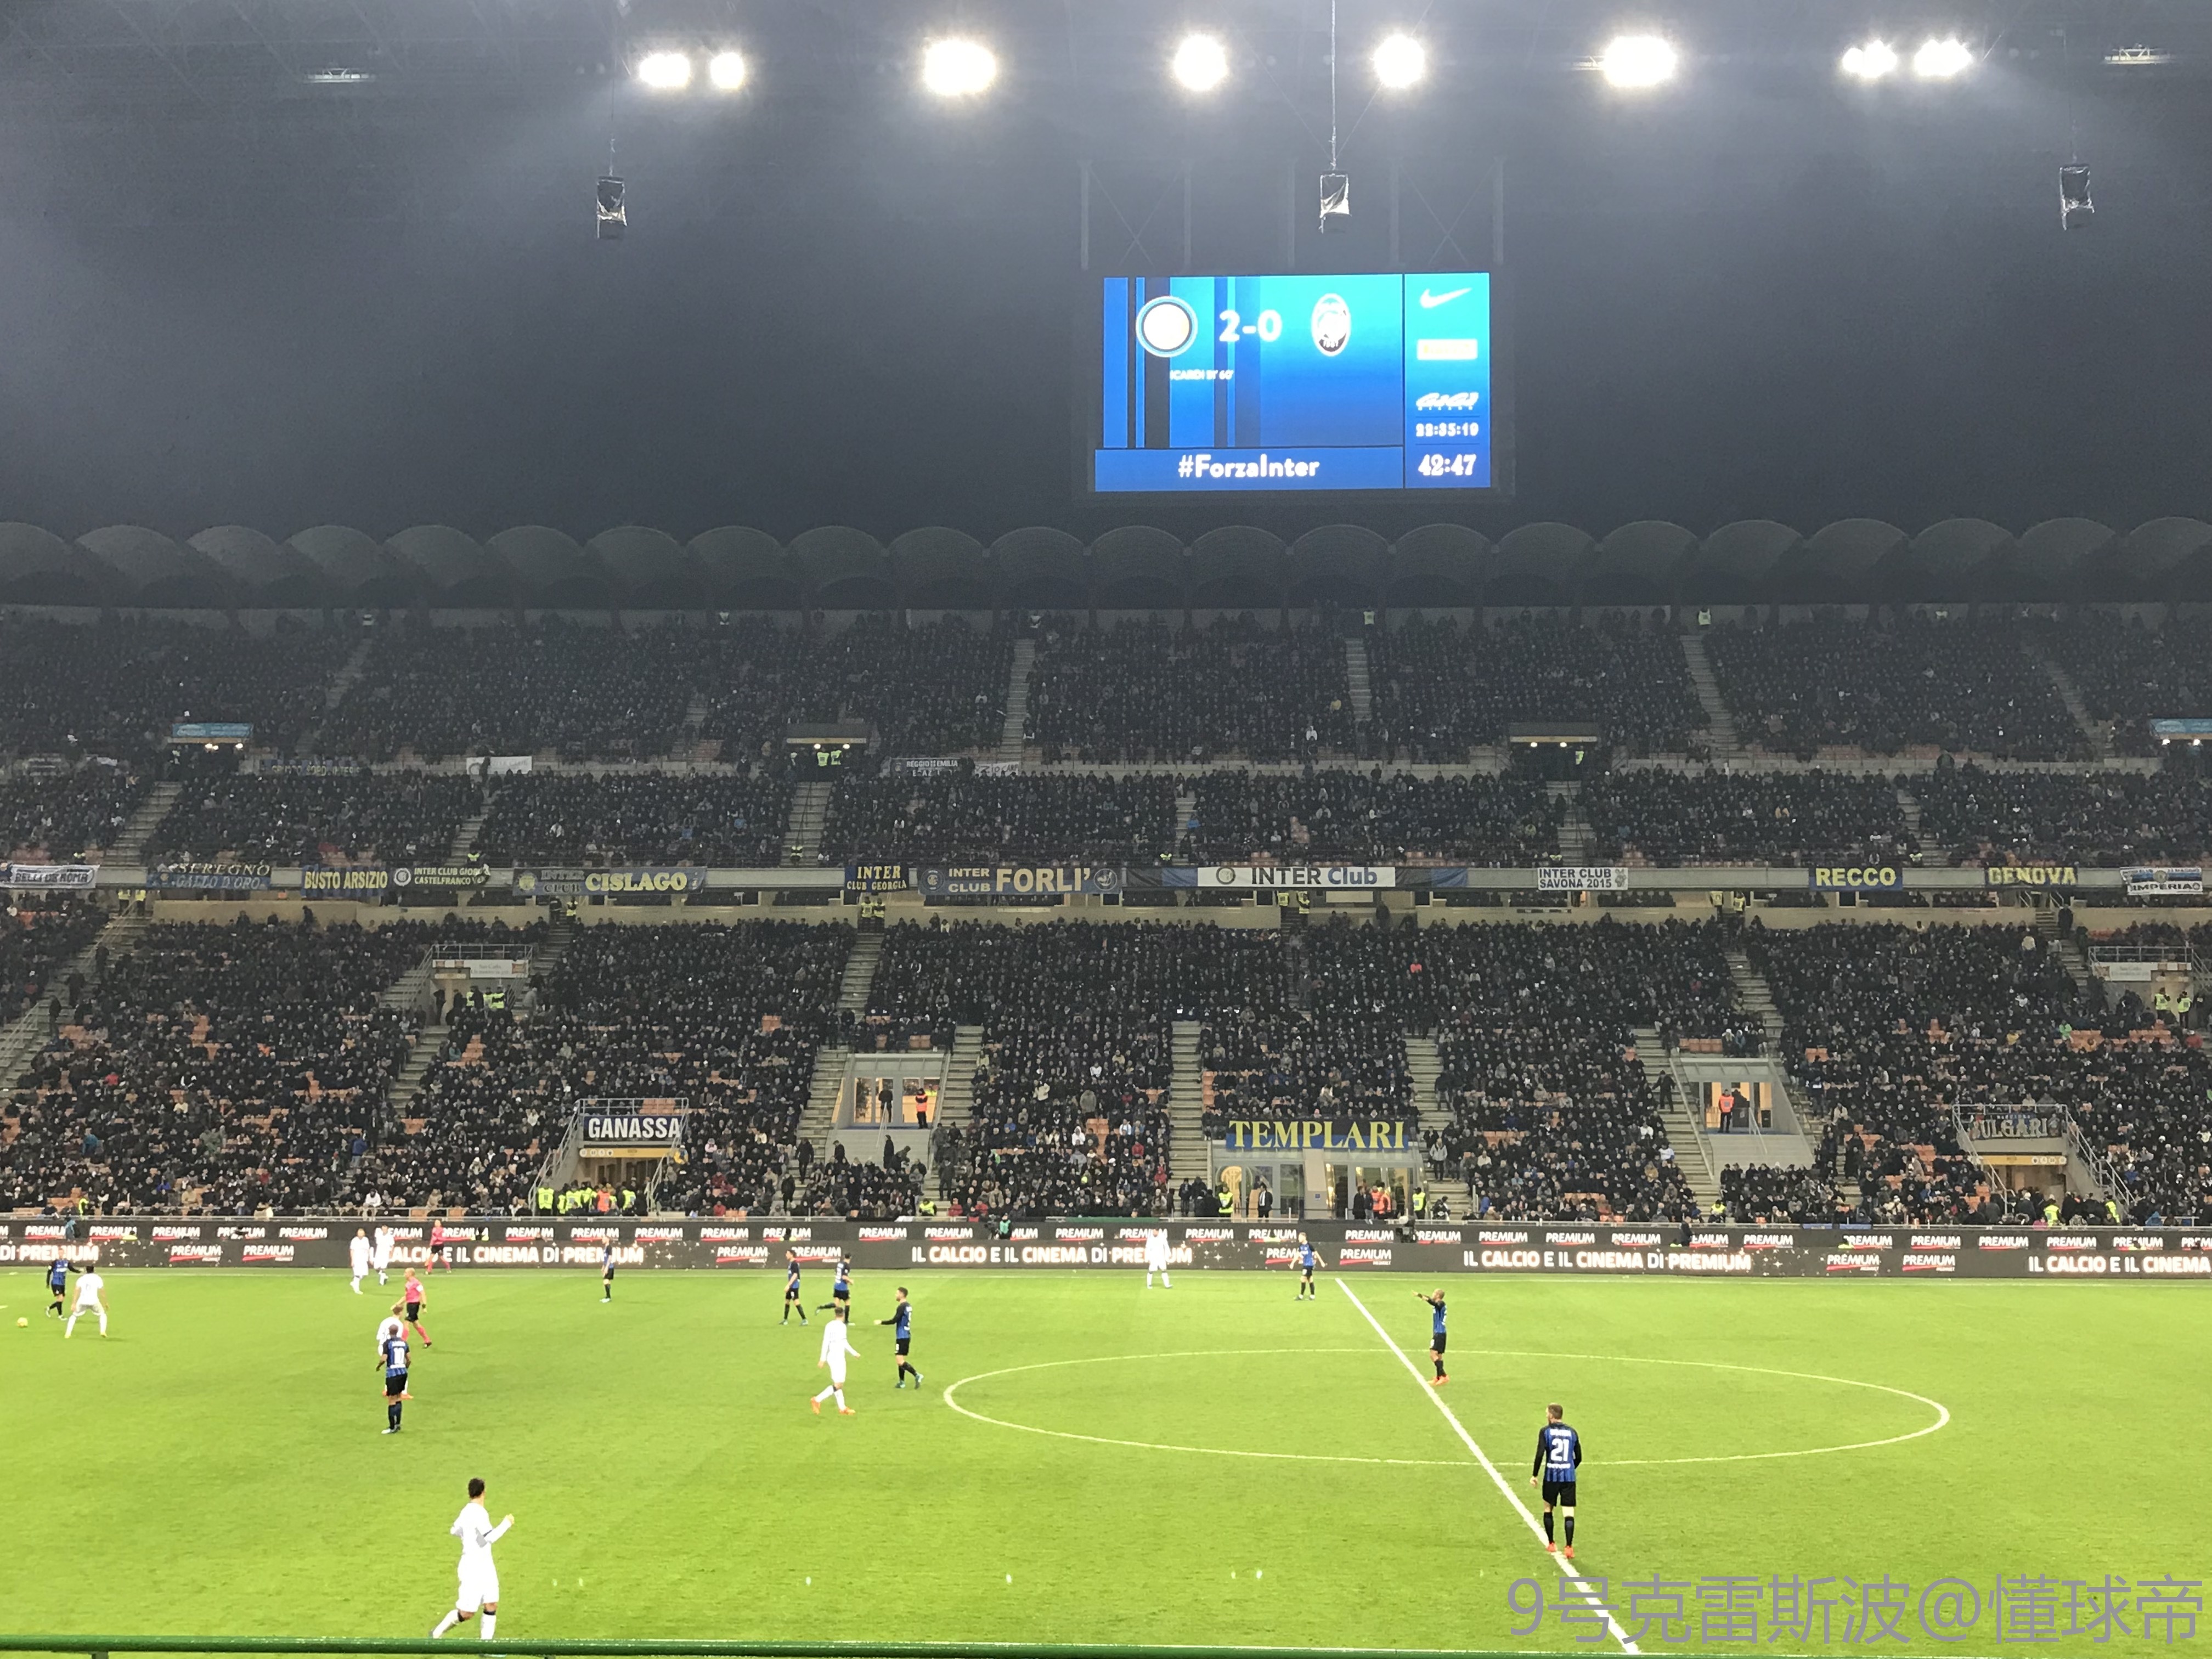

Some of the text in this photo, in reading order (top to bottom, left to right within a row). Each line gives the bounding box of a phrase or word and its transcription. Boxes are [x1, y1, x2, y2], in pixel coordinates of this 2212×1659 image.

[1218, 309, 1283, 342] 2-0
[1178, 455, 1320, 478] #ForzaInter
[1418, 454, 1476, 476] 42:47
[414, 867, 437, 876] INTER
[438, 867, 458, 876] CLUB
[541, 870, 585, 880] INTER
[857, 866, 901, 879] INTER
[949, 868, 990, 877] INTER
[1251, 867, 1378, 885] INTER Club
[1539, 868, 1612, 878] INTER CLUB
[1815, 868, 1896, 886] RECCO
[1988, 867, 2078, 885] GENOVA
[304, 870, 387, 890] BUSTO ARSIZIO
[414, 876, 471, 885] CASTELFRANCO
[585, 872, 688, 891] CISLAGO
[846, 879, 907, 890] CLUB GEORGIA
[996, 868, 1091, 893] FORLI'
[1539, 879, 1612, 889] SAVONA 2015
[544, 883, 582, 893] CLUB
[948, 883, 990, 893] CLUB
[588, 1118, 680, 1139] GANASSA
[1228, 1120, 1404, 1149] TEMPLARI
[26, 1226, 66, 1236] PREMIU
[153, 1226, 200, 1237] PREMIUM
[279, 1227, 327, 1238] PREMIUM
[375, 1227, 422, 1238] PEMIUM
[571, 1228, 619, 1238] PREMIUM
[635, 1228, 682, 1238] PREMIUM
[701, 1228, 749, 1238] PREMIUM
[859, 1228, 907, 1238] PREMIUM
[925, 1228, 973, 1238] PREMIUM
[1012, 1228, 1038, 1238] MIUM
[1056, 1228, 1103, 1238] PREMIUM
[1186, 1228, 1234, 1239] PREMIUM
[1345, 1230, 1393, 1240] PREMIUM
[1479, 1232, 1527, 1242] PREMIUM
[1546, 1233, 1595, 1243] PREMIUM
[1612, 1233, 1661, 1244] PREMIUM
[1692, 1234, 1729, 1244] EMIUM
[1743, 1234, 1793, 1245] PREMIUM
[1911, 1235, 1961, 1246] PREMIUM
[1979, 1237, 2029, 1246] PREMIUM
[2047, 1237, 2096, 1247] PREMIUM
[0, 1246, 15, 1260] DI
[171, 1245, 222, 1256] PREMIUM
[243, 1245, 294, 1256] PREMIUM
[384, 1246, 438, 1262] ALCI
[456, 1246, 471, 1262] IL
[473, 1246, 539, 1263] CINEMA
[544, 1246, 559, 1262] DI
[717, 1246, 768, 1257] PREMIUM
[912, 1246, 1193, 1263] IL CALCIO E IL CINEMA DI PREUM
[1340, 1249, 1391, 1260] PREMIUM
[1464, 1250, 1751, 1270] IL CALCIO E IL CINEMA DI PREMIUM
[1827, 1254, 1880, 1265] PREMIUM
[1903, 1255, 1955, 1266] PREMIUM
[2028, 1256, 2211, 1273] IL CALCIO E IL CINEMA
[1550, 1438, 1570, 1462] 21
